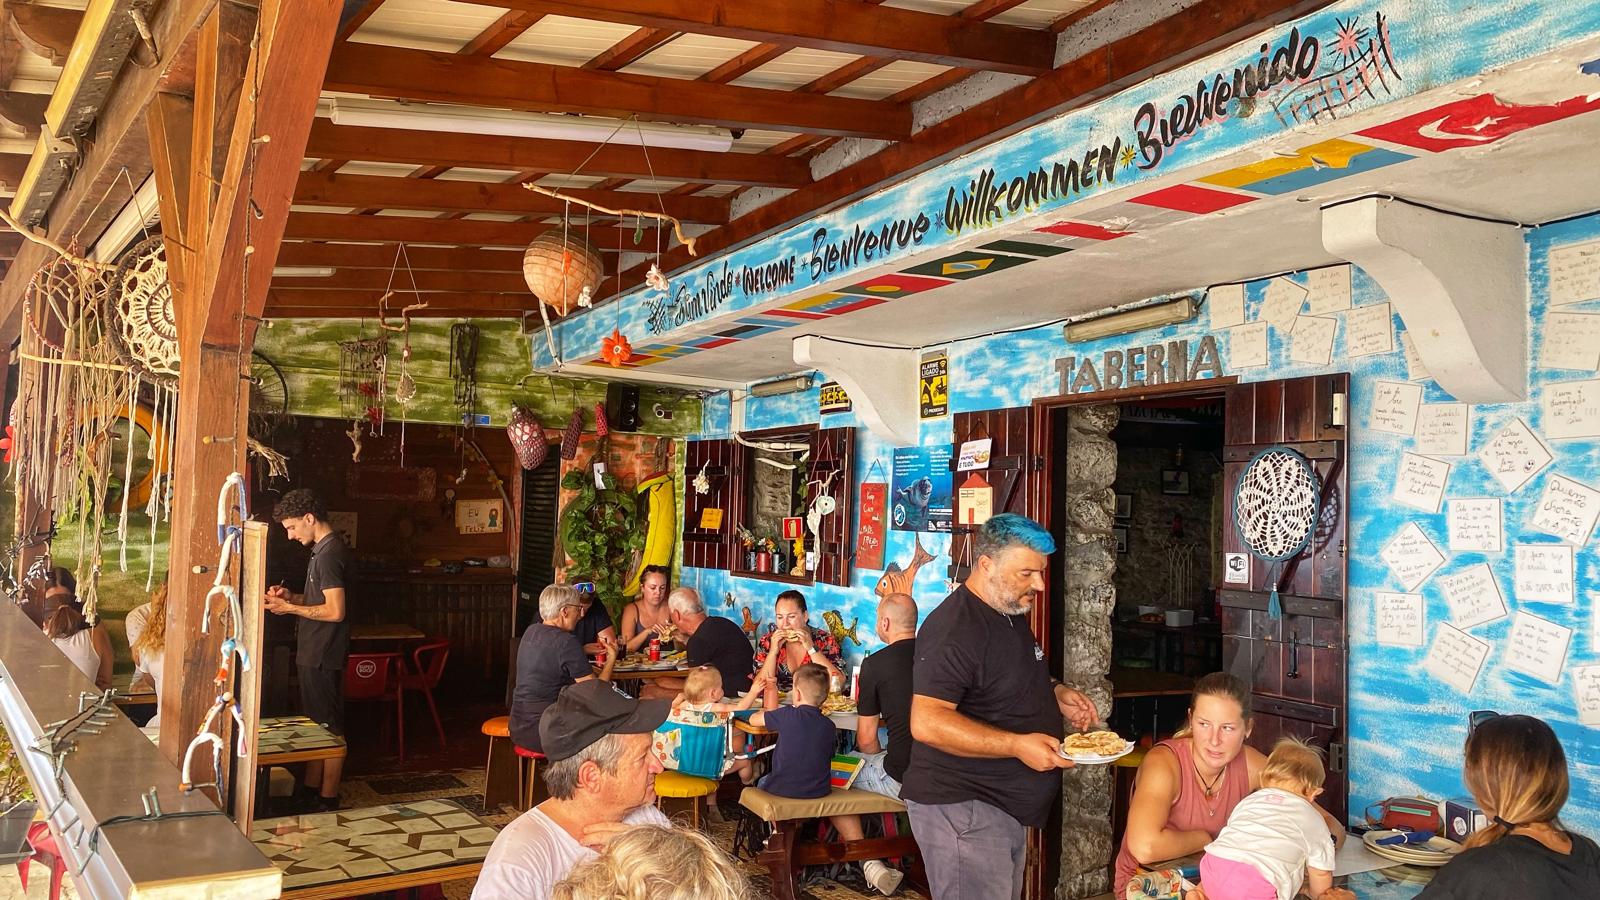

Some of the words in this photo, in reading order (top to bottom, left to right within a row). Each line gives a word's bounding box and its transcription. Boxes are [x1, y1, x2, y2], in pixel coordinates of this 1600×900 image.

[743, 256, 796, 297] WELCOME
[1134, 26, 1318, 170] Bienvenido
[922, 361, 939, 370] ALARME
[1055, 335, 1224, 396] TABERNA
[922, 367, 940, 377] LIGADO
[1550, 479, 1586, 500] Quem
[1562, 498, 1586, 509] não
[1561, 516, 1583, 527] não
